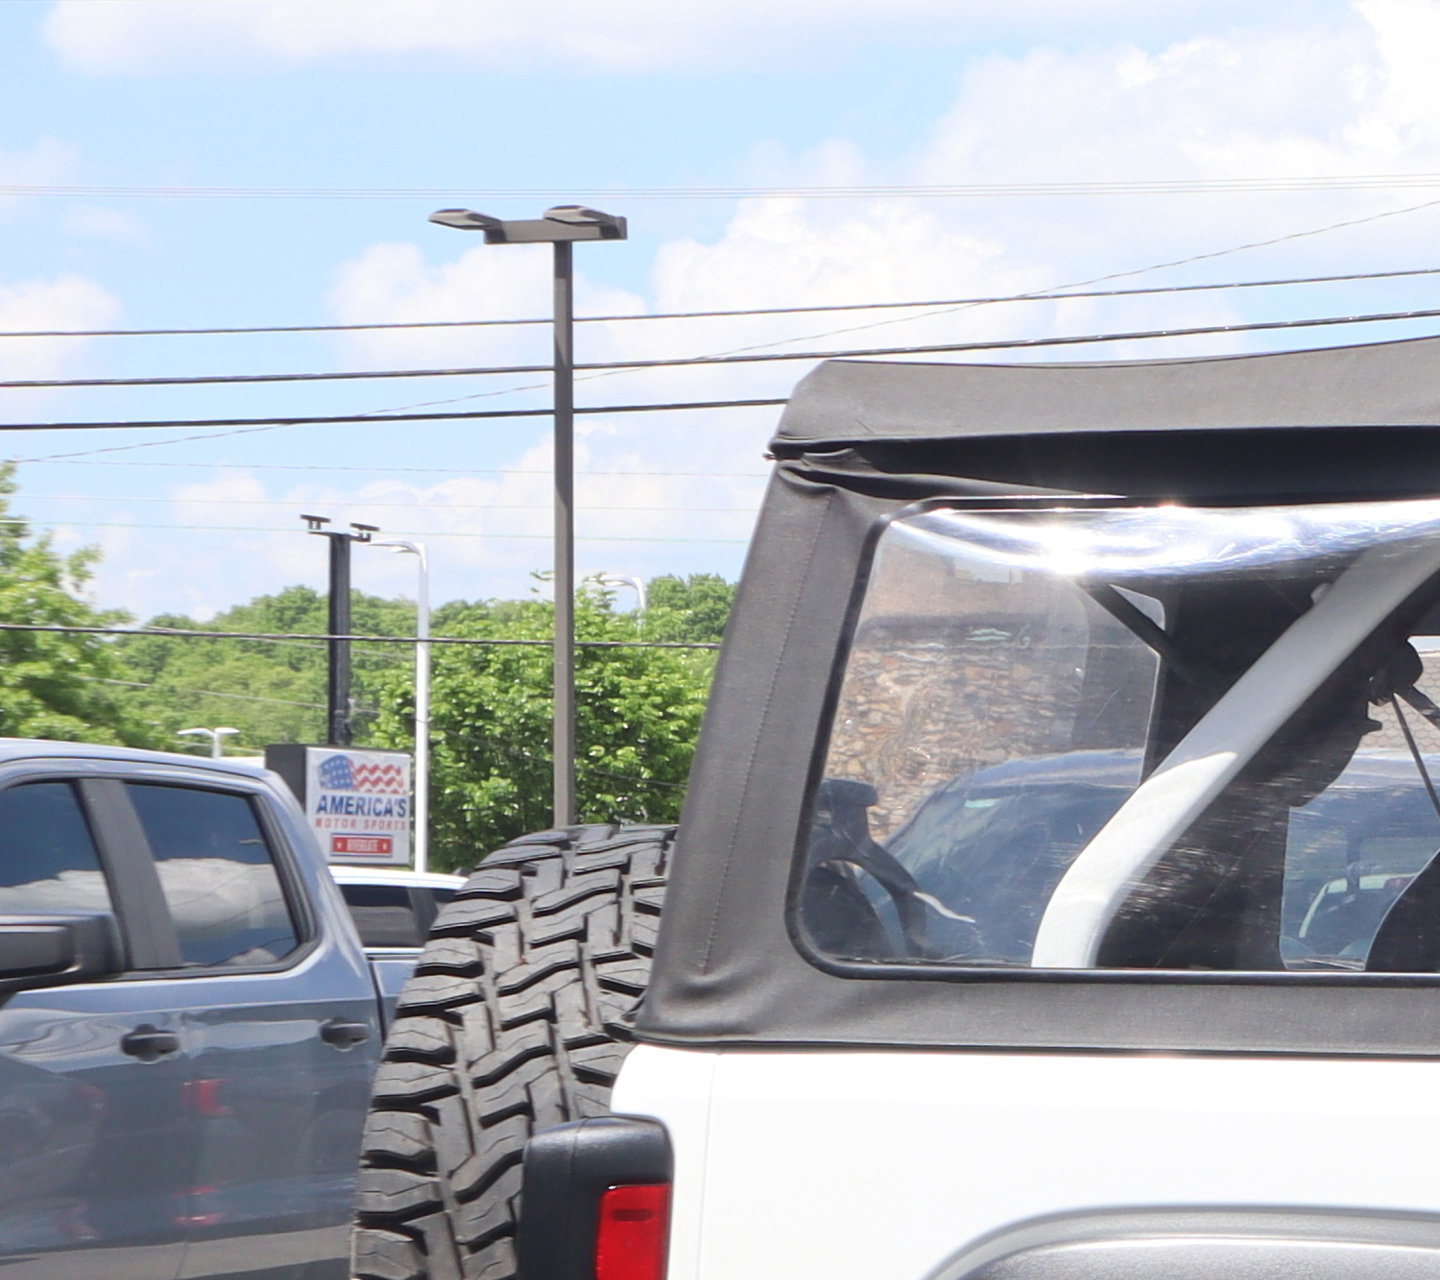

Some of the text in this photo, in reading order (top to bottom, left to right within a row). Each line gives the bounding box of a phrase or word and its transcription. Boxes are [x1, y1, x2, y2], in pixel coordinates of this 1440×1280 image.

[316, 795, 407, 817] AMERICA'S
[315, 818, 406, 830] MOTOR SPORTS
